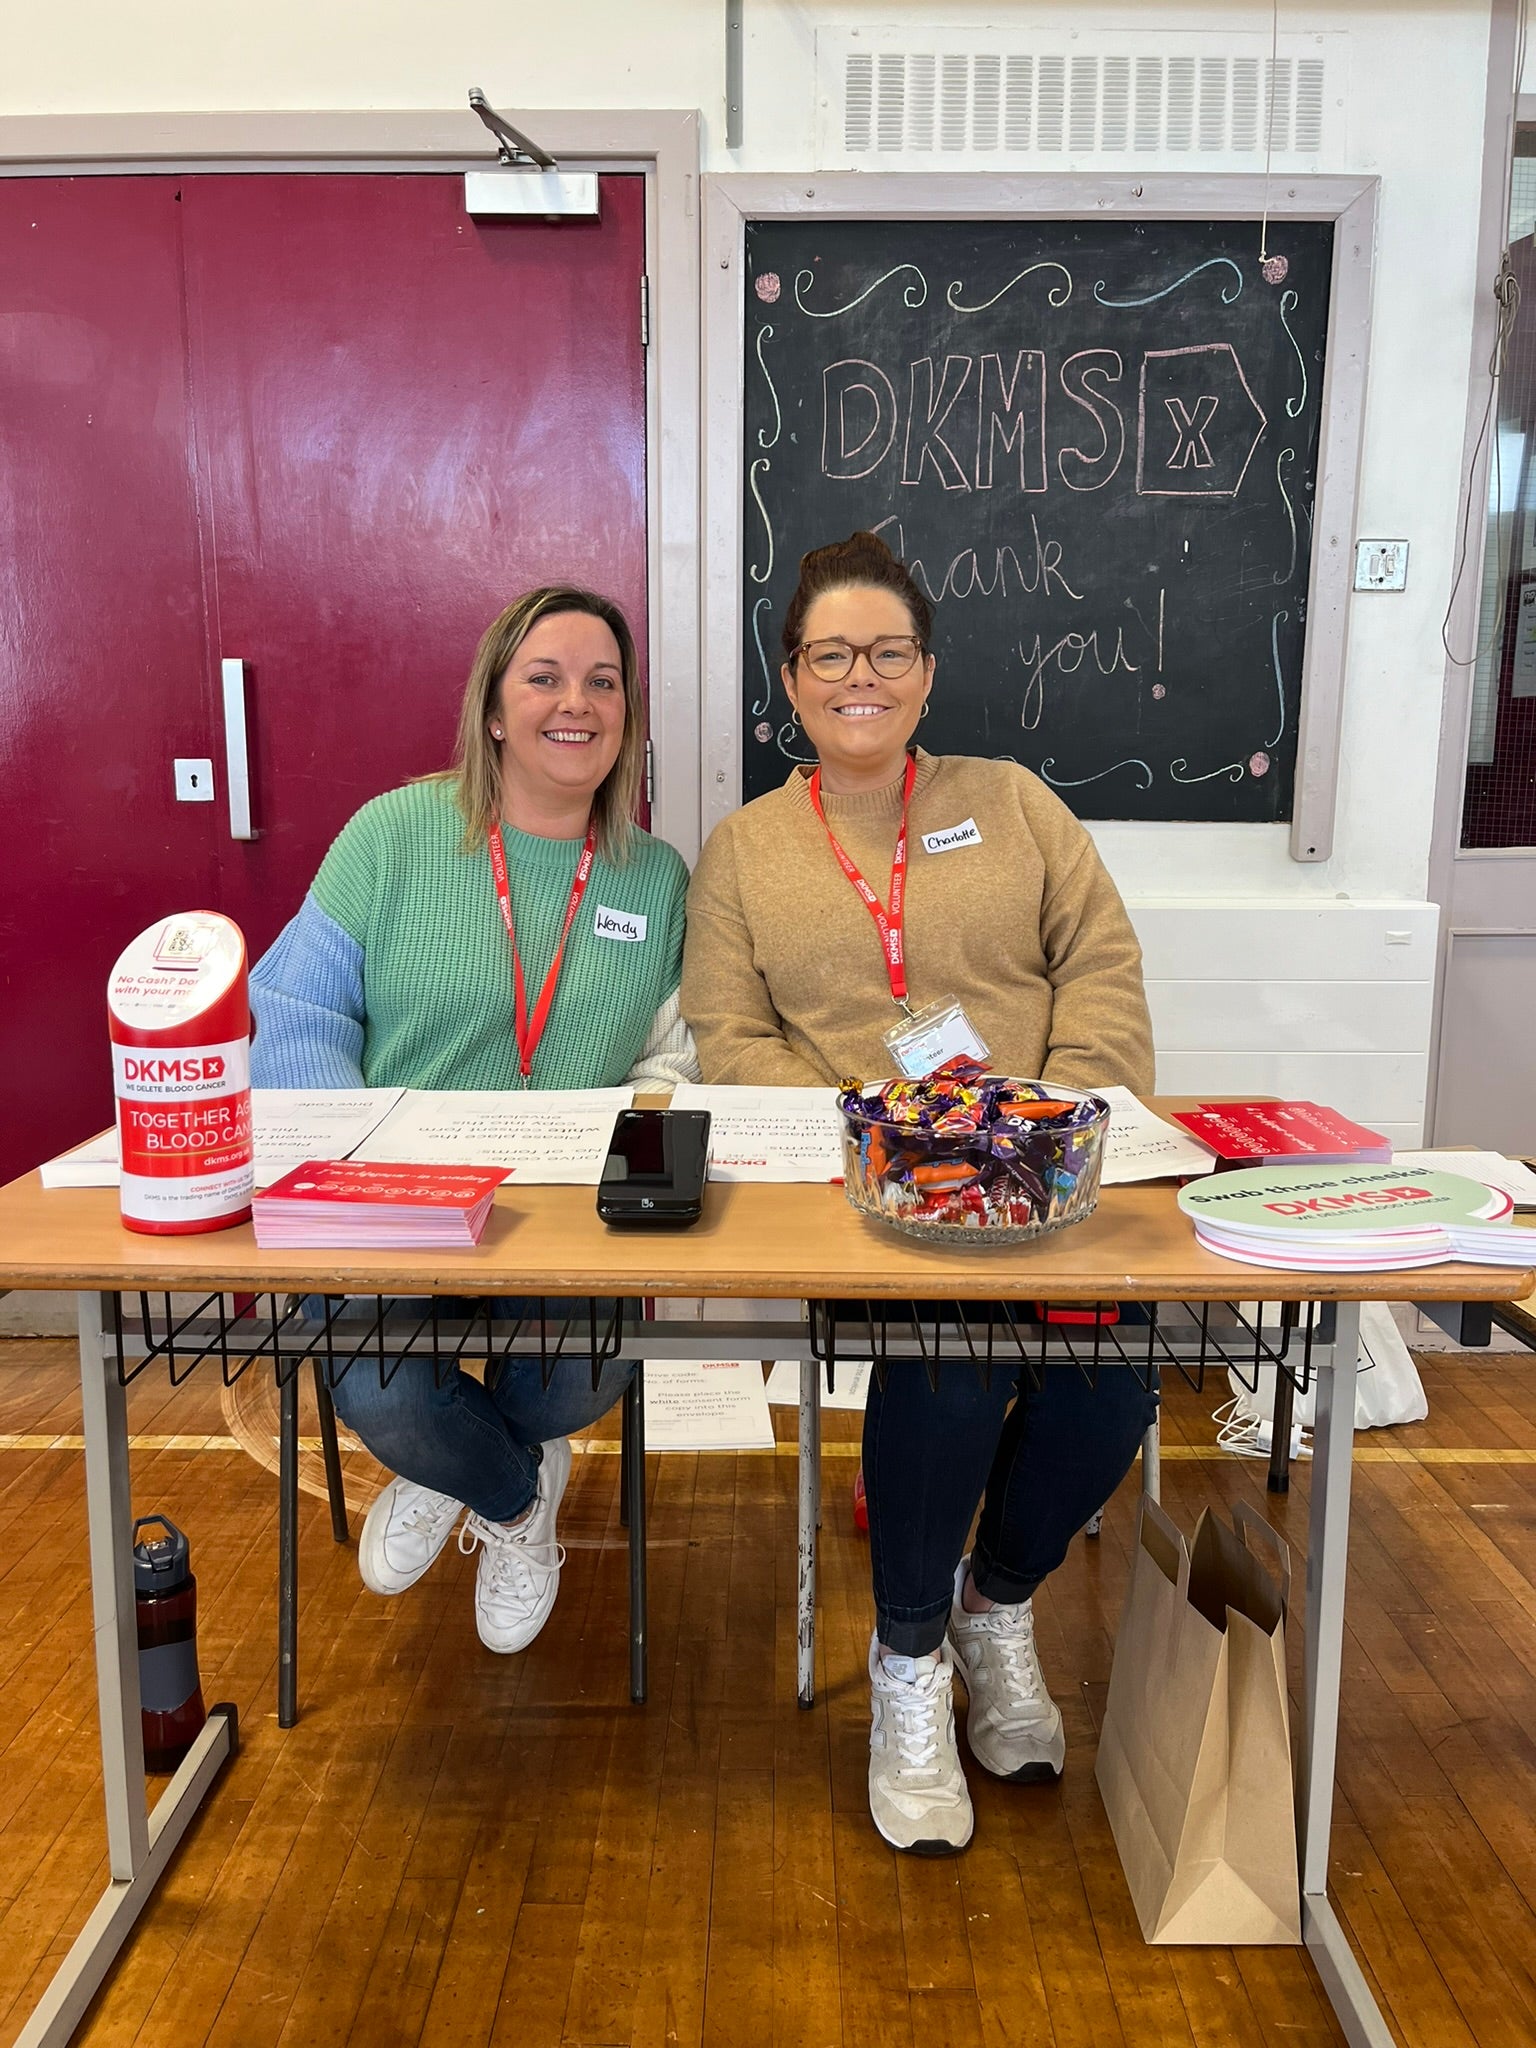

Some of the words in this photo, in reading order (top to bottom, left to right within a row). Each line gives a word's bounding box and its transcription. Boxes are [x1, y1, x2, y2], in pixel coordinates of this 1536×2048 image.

[822, 348, 1125, 493] DKMS
[1018, 587, 1167, 730] you!
[927, 828, 977, 850] Charlotte
[490, 833, 505, 883] VOLUNTEER
[891, 872, 903, 915] VOLUNTEER
[597, 912, 638, 939] Wendy
[890, 938, 900, 965] DKMS
[117, 975, 134, 984] No
[137, 975, 176, 985] Cash?
[114, 986, 140, 995] with
[143, 987, 171, 997] your
[124, 1057, 201, 1082] DKMS
[126, 1083, 135, 1091] WE
[136, 1084, 163, 1093] DELETE
[165, 1084, 194, 1093] BLOOD
[195, 1081, 226, 1091] CANCER
[129, 1107, 231, 1129] TOGETHER
[146, 1130, 219, 1150] BLOOD
[1125, 1145, 1178, 1156] Drive
[179, 1192, 203, 1202] trading
[190, 1183, 221, 1193] CONNECT
[1189, 1189, 1264, 1204] Swab
[1265, 1180, 1337, 1194] those
[1342, 1168, 1434, 1186] cheeks!
[1263, 1190, 1399, 1216] DKMS
[1295, 1213, 1314, 1222] WE
[1318, 1206, 1361, 1219] DELETE
[1361, 1201, 1404, 1213] BLOOD
